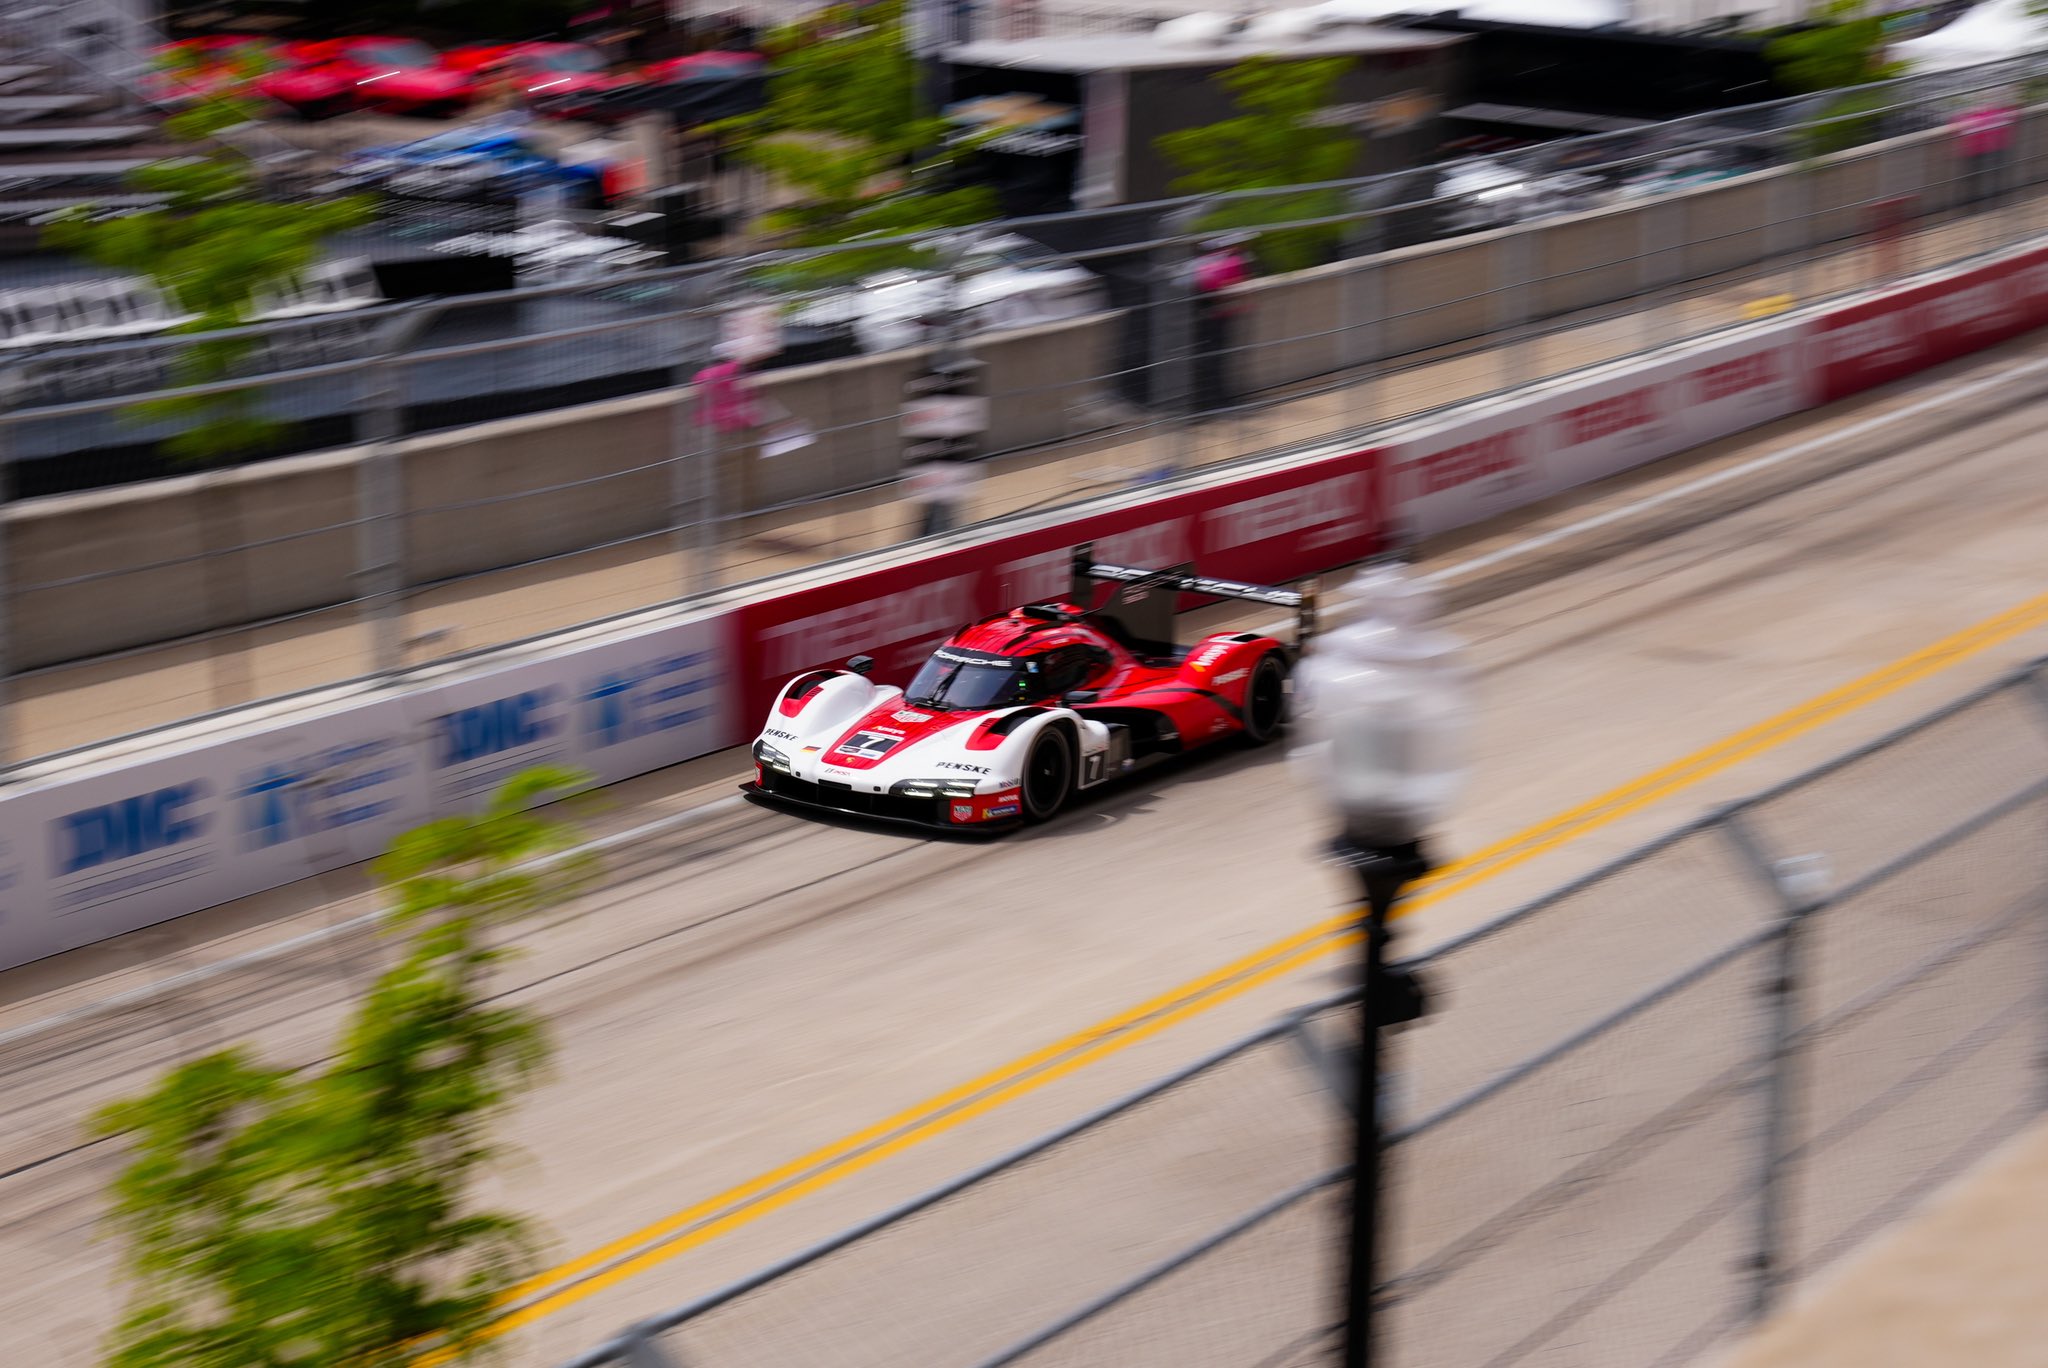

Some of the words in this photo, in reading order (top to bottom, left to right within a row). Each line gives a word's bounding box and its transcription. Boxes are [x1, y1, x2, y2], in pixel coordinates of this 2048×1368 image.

[764, 728, 799, 741] PENSKE
[860, 735, 887, 750] 7
[935, 761, 992, 775] PENSKE
